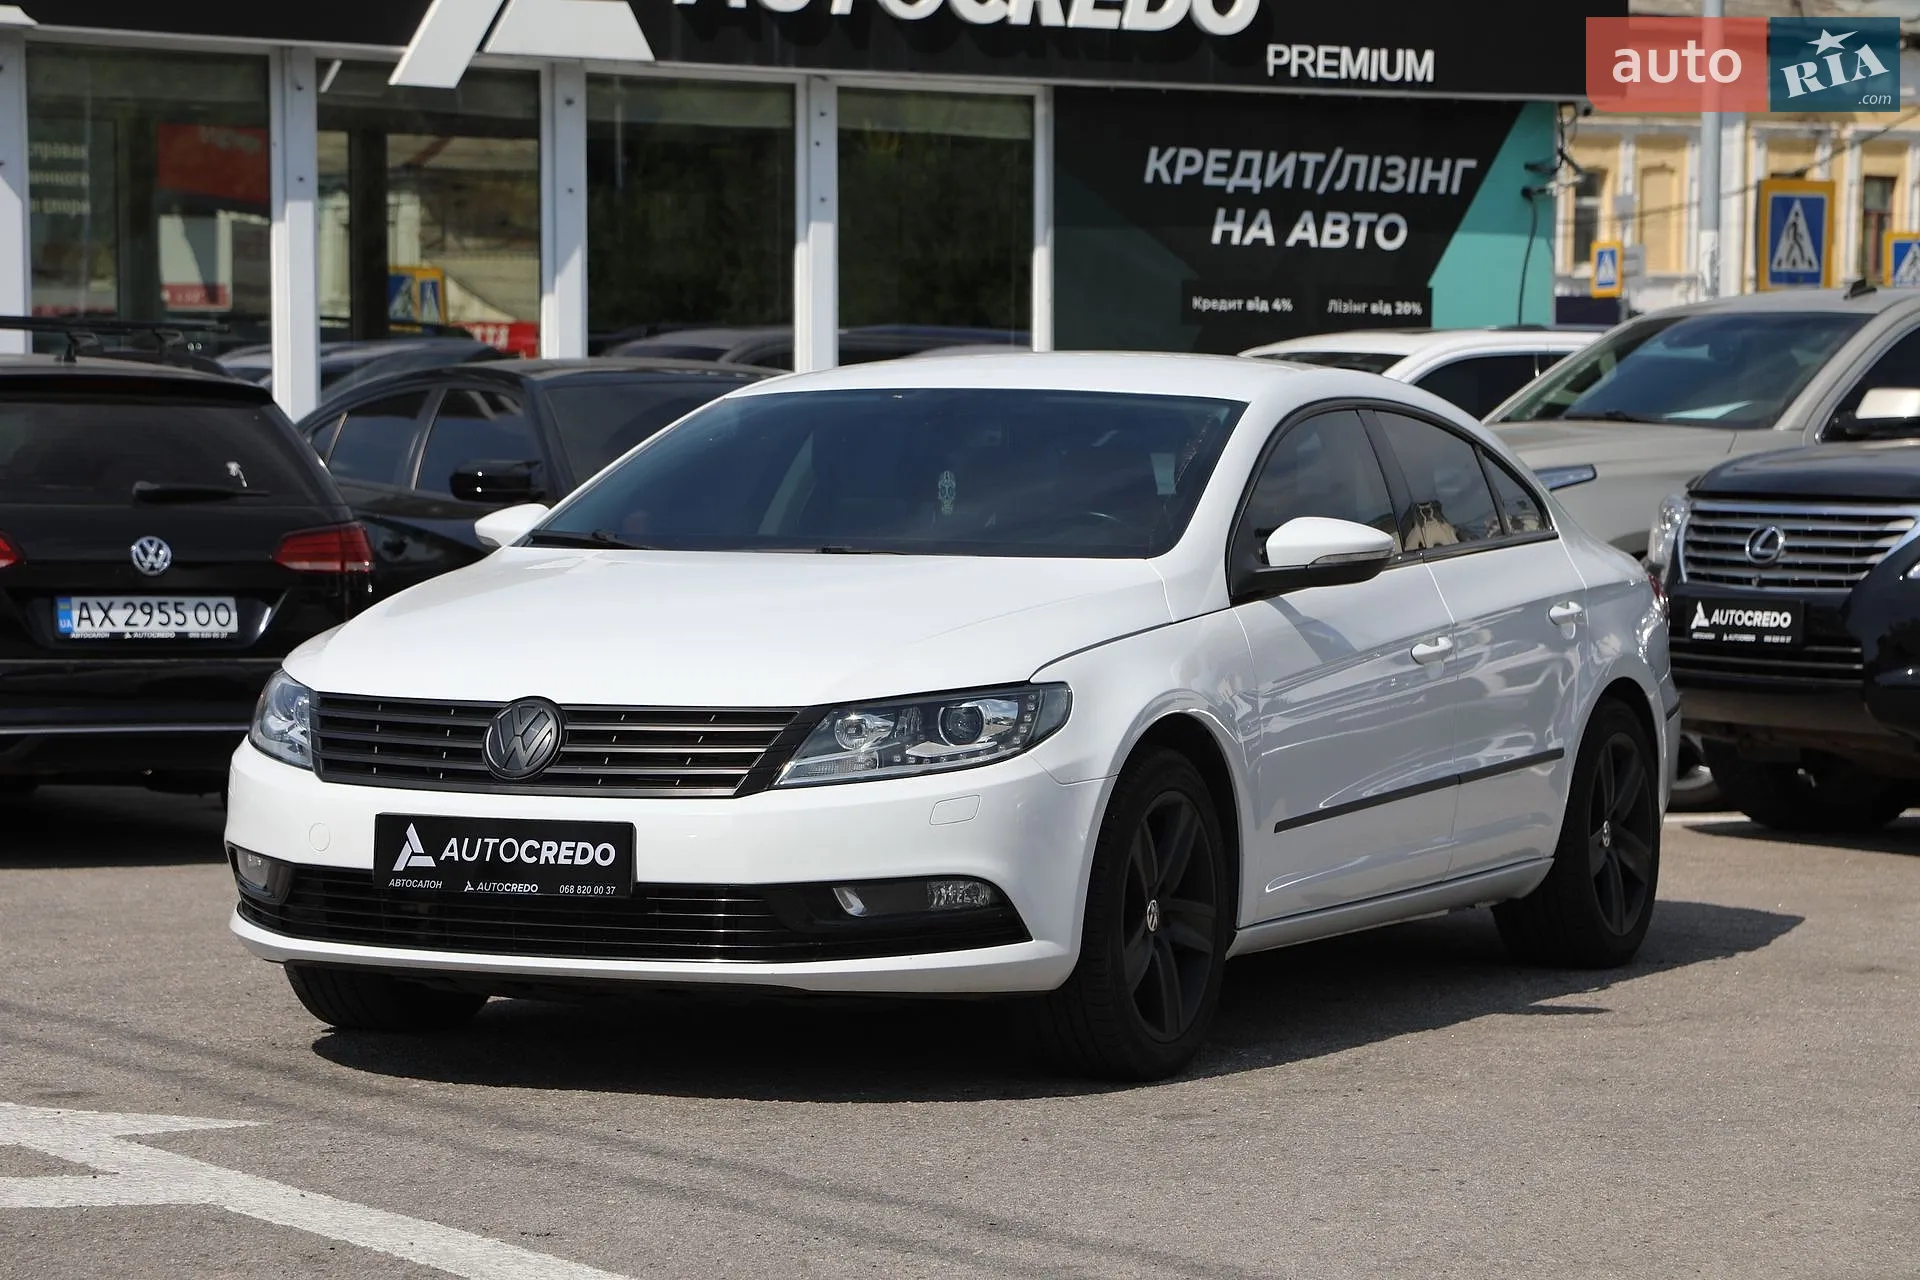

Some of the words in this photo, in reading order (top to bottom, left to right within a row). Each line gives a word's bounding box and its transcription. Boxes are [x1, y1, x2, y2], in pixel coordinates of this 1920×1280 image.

[1266, 43, 1435, 83] PREMIUM
[1143, 146, 1478, 195] КРЕДИТ/ЛІЗІНГ
[1210, 207, 1276, 246] НА
[1285, 209, 1409, 251] АВТО
[1192, 296, 1244, 312] Кредит
[1246, 296, 1269, 313] від
[1271, 297, 1294, 312] 4%
[1327, 298, 1369, 314] Лізінг
[1370, 299, 1393, 316] від
[1395, 300, 1423, 316] 20%
[77, 602, 116, 628] AX
[123, 602, 188, 627] 2955
[1710, 608, 1792, 629] AUTOCREDO
[439, 837, 616, 867] AUTOCREDO
[388, 878, 443, 889] АВТОСАЛОН
[477, 882, 539, 893] AUTOCREDO
[559, 884, 575, 894] 068
[576, 885, 592, 895] 820
[593, 886, 604, 895] 00
[605, 886, 616, 896] 37
